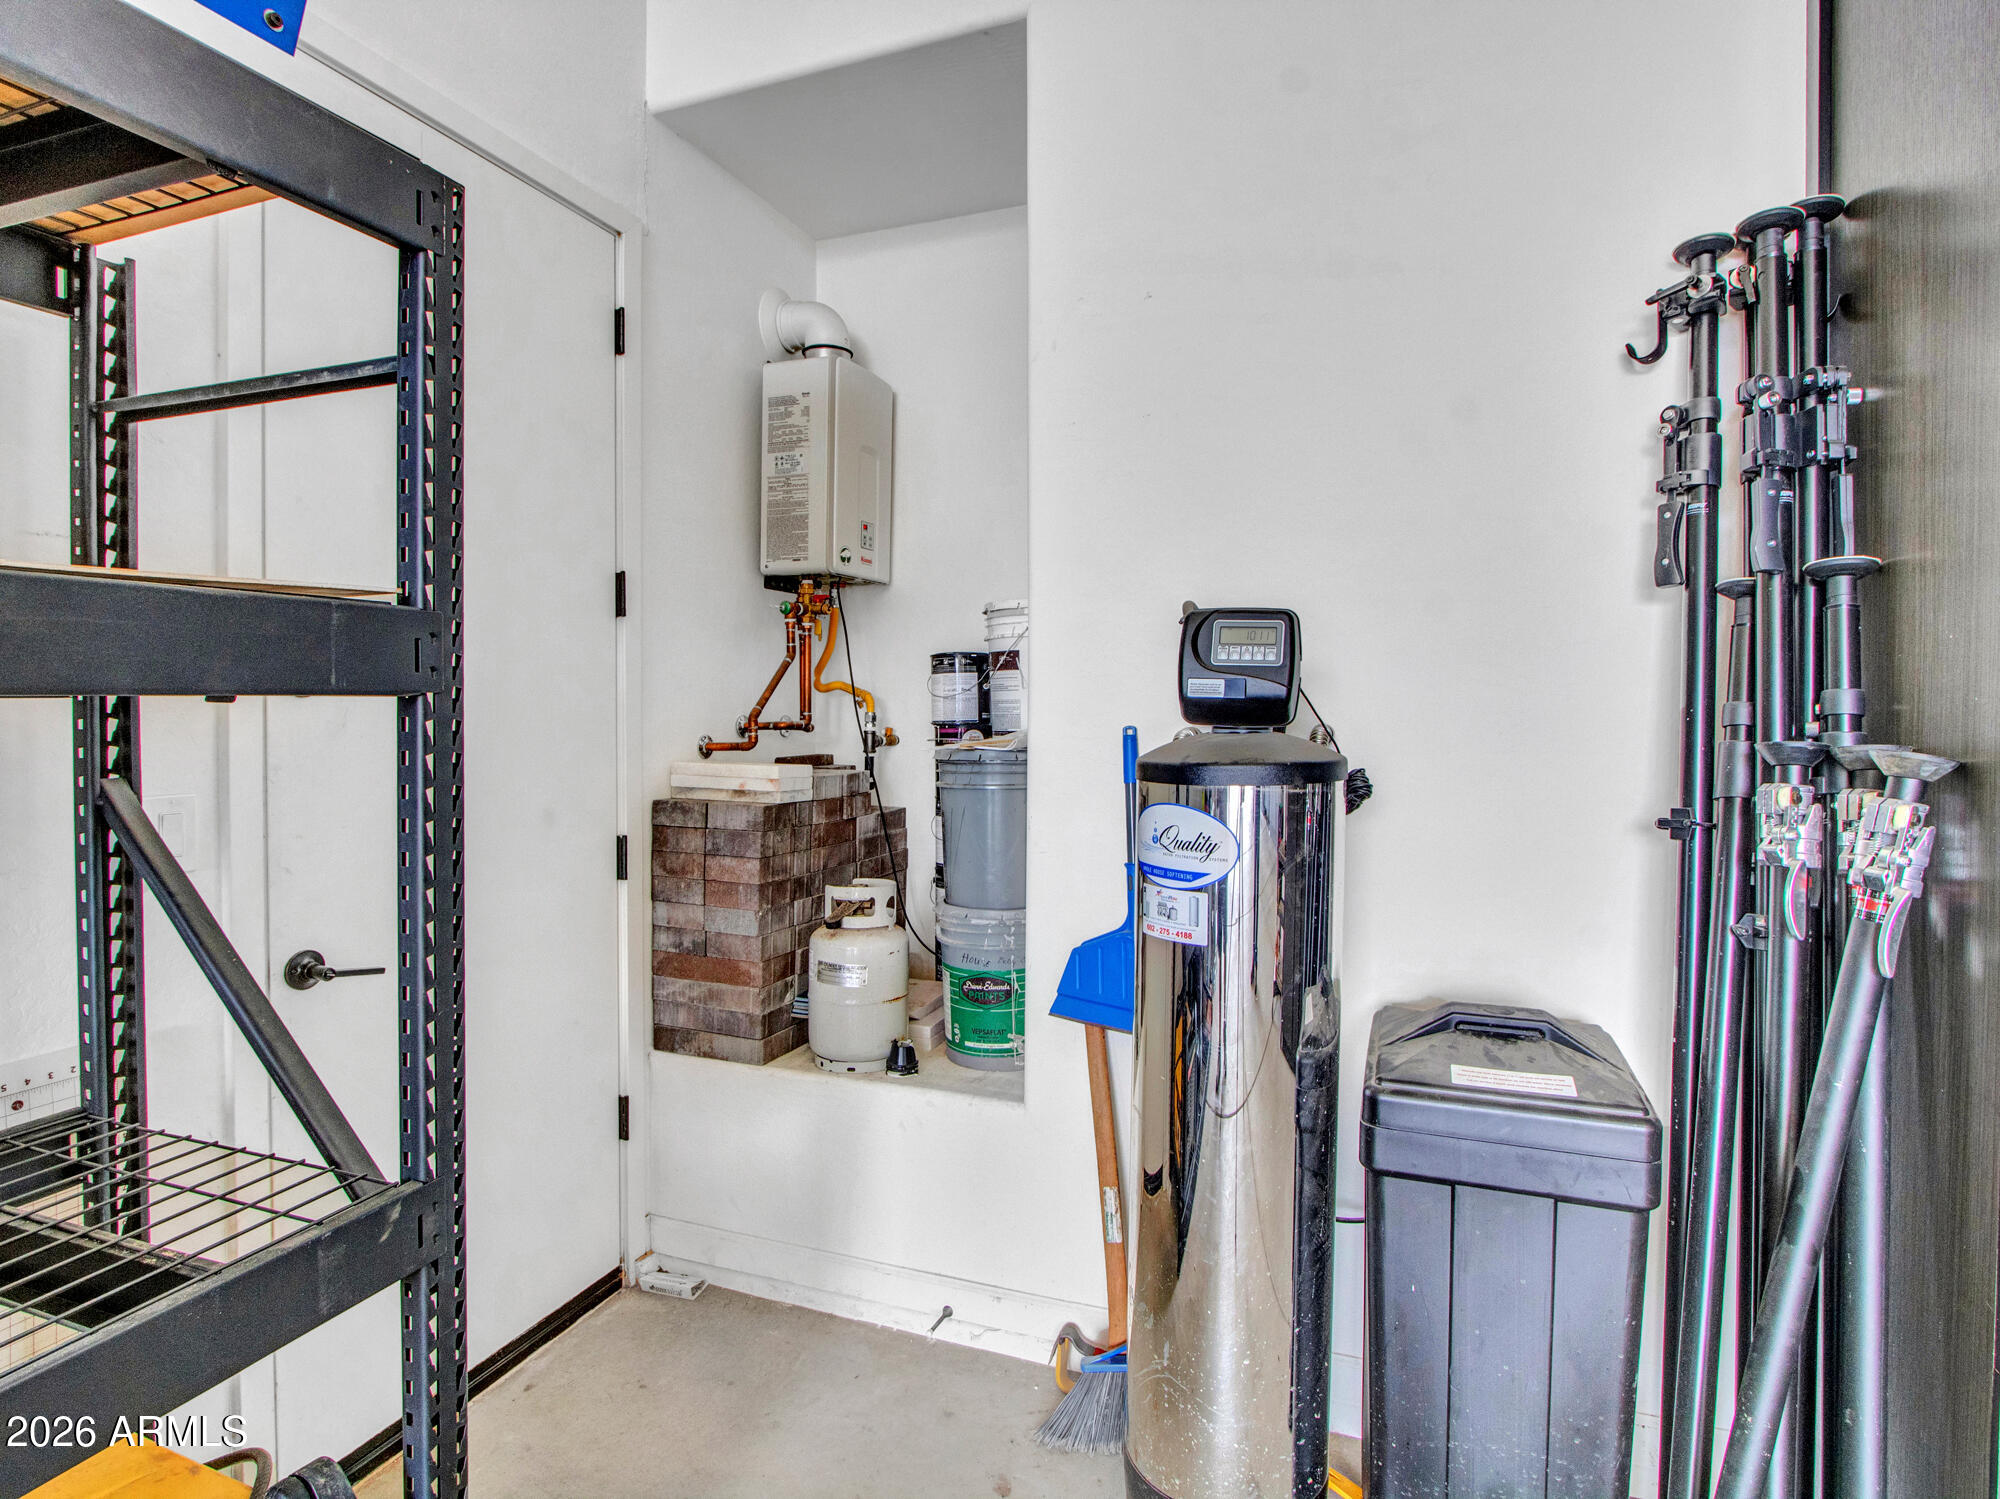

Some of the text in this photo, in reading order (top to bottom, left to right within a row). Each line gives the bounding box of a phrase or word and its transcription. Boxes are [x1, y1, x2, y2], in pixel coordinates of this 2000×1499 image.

[1159, 825, 1221, 863] Quality
[1166, 870, 1193, 880] SOFTENING
[1159, 926, 1171, 936] 275
[1176, 929, 1193, 940] 4188
[968, 991, 1006, 1001] PAINTS
